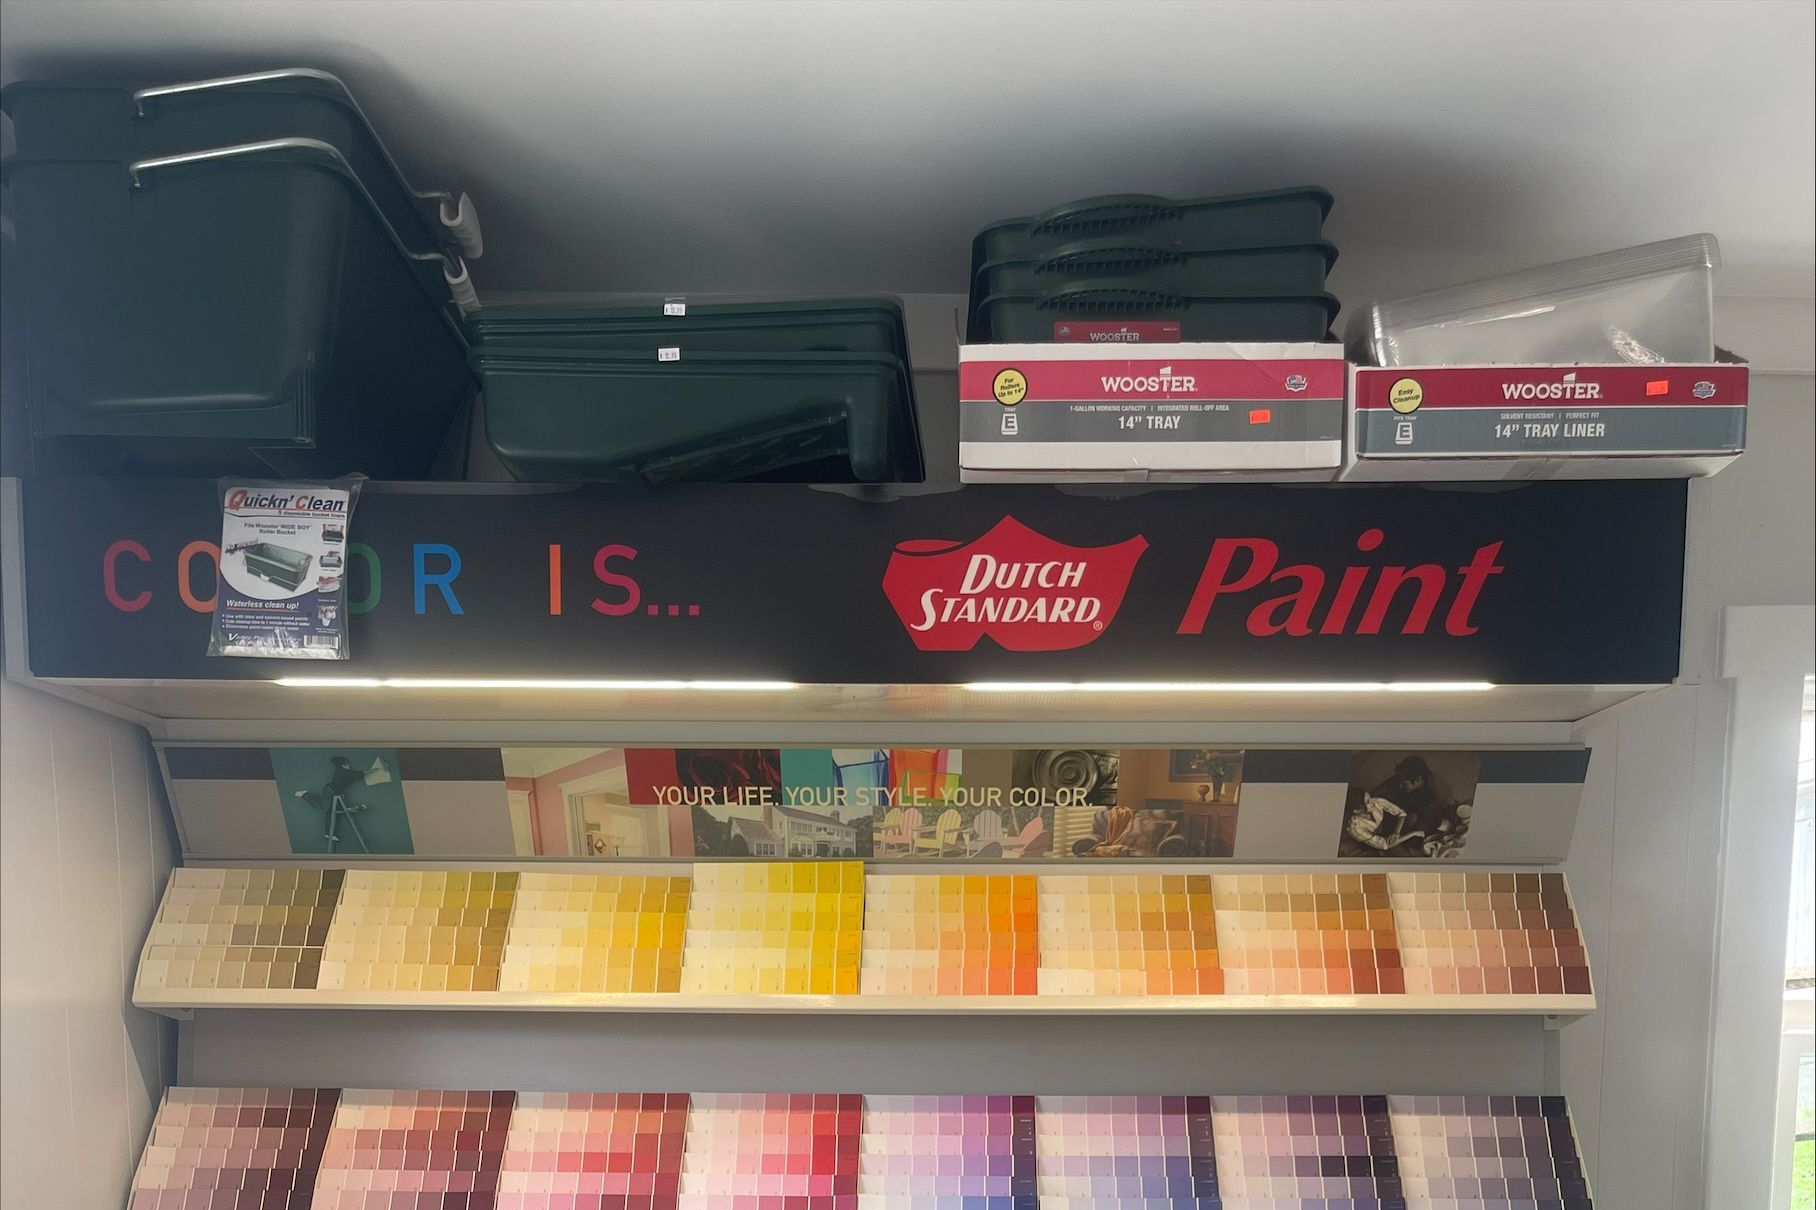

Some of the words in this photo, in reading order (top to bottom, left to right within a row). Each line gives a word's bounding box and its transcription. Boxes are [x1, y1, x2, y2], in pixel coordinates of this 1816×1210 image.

[1090, 332, 1140, 342] WOOSTER
[1000, 383, 1020, 391] Rollers
[1101, 376, 1197, 393] WOOSTER
[1502, 383, 1601, 400] WOOSTER
[1393, 394, 1420, 404] Cleanup
[1004, 415, 1015, 429] E
[1146, 416, 1181, 430] TRAY
[1500, 412, 1524, 420] SOLVENT
[1400, 425, 1410, 438] E
[1523, 423, 1559, 438] TRAY
[1564, 423, 1606, 438] LINER
[295, 495, 344, 511] Clean
[103, 539, 464, 616] COOR
[960, 553, 1088, 595] DUTCH
[1177, 528, 1505, 637] Paint
[226, 600, 263, 608] Waterless
[264, 601, 285, 609] clean
[286, 602, 299, 611] up!
[652, 786, 716, 807] YOUR
[723, 786, 779, 807] LIFE.
[784, 786, 848, 807] YOUR
[855, 786, 933, 807] STYLE.
[939, 787, 1003, 807] YOUR
[1008, 787, 1093, 808] COLOR.
